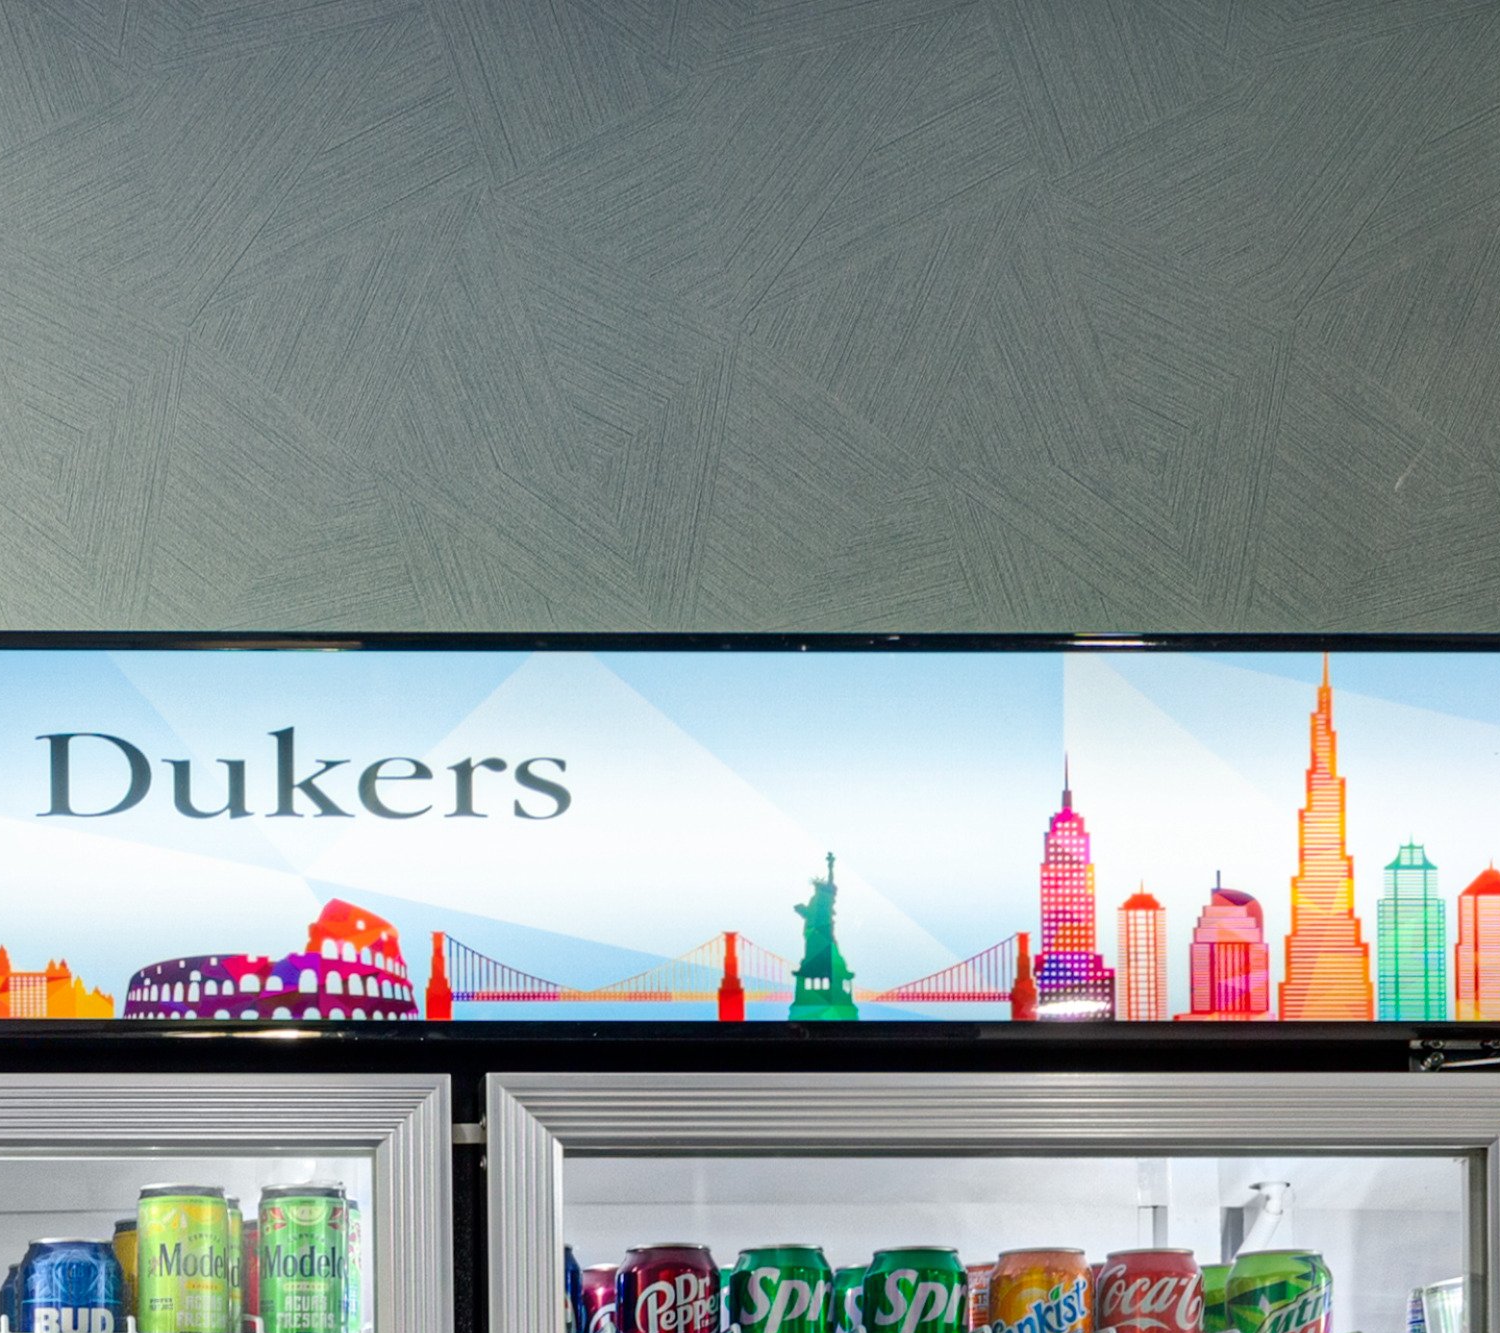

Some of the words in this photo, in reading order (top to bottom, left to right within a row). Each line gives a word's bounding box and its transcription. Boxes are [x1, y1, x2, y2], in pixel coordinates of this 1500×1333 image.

[35, 725, 572, 821] Dukers
[676, 1273, 711, 1301] Dr
[33, 1308, 115, 1333] BUD
